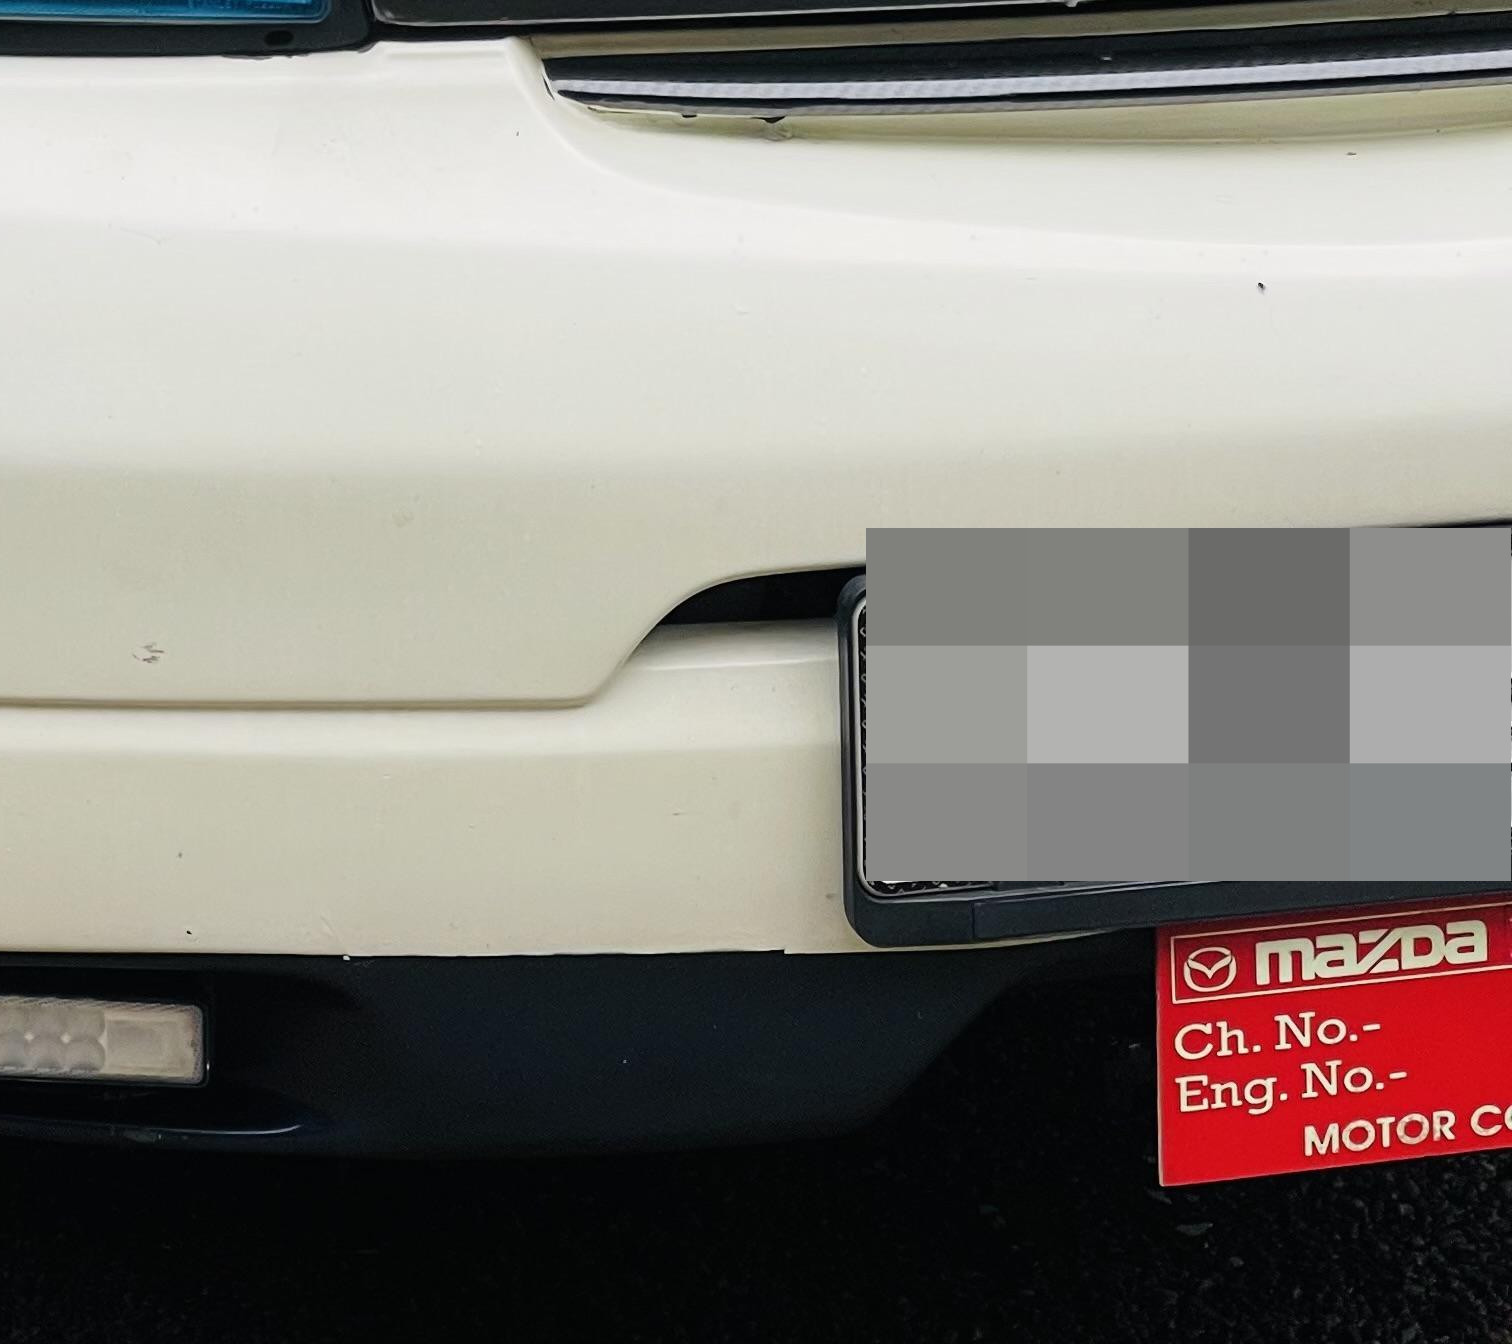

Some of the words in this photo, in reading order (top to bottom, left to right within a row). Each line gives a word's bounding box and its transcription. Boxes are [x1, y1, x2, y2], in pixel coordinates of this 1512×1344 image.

[1173, 1020, 1262, 1061] Ch.
[1174, 1074, 1289, 1116] Eng.
[1303, 1109, 1456, 1157] MOTOR
